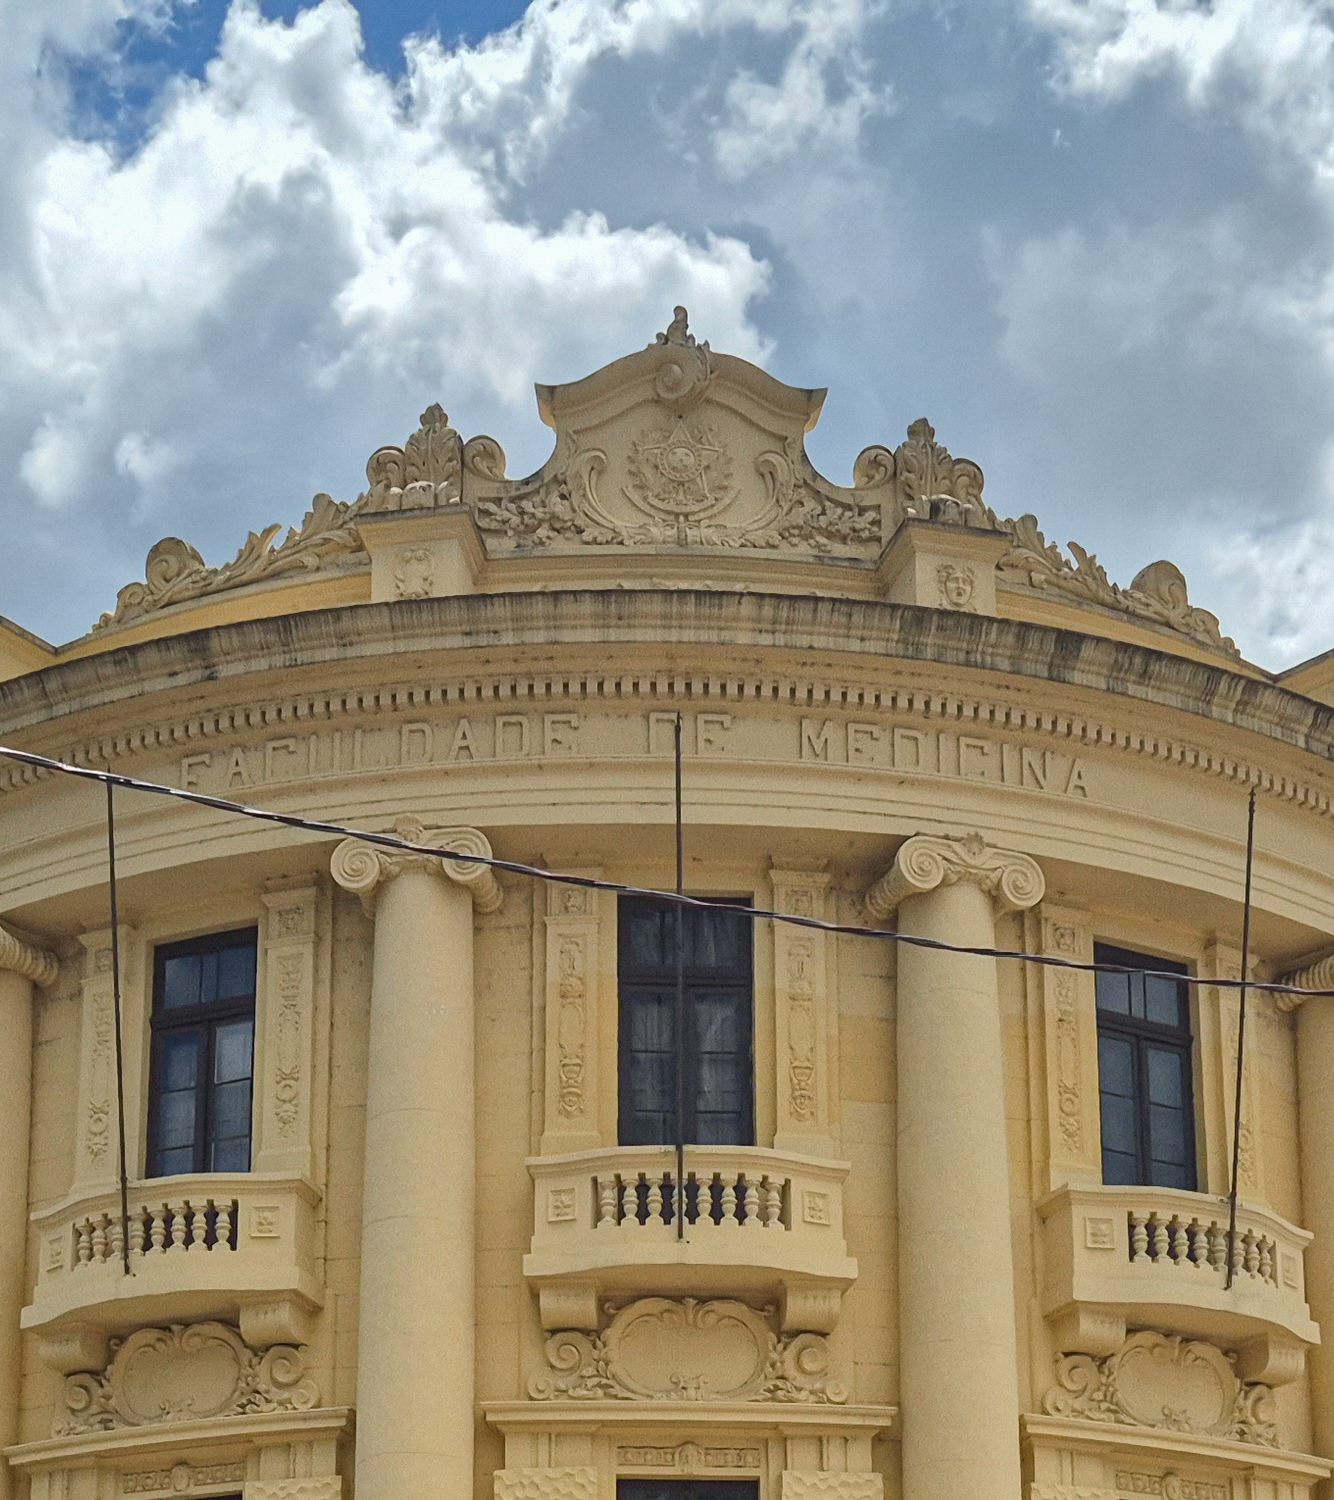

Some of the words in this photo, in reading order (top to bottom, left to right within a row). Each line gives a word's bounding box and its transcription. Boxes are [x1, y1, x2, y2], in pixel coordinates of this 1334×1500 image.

[181, 712, 580, 789] FACULDADE
[648, 712, 733, 757] DE
[799, 717, 1089, 798] MEDICINA
